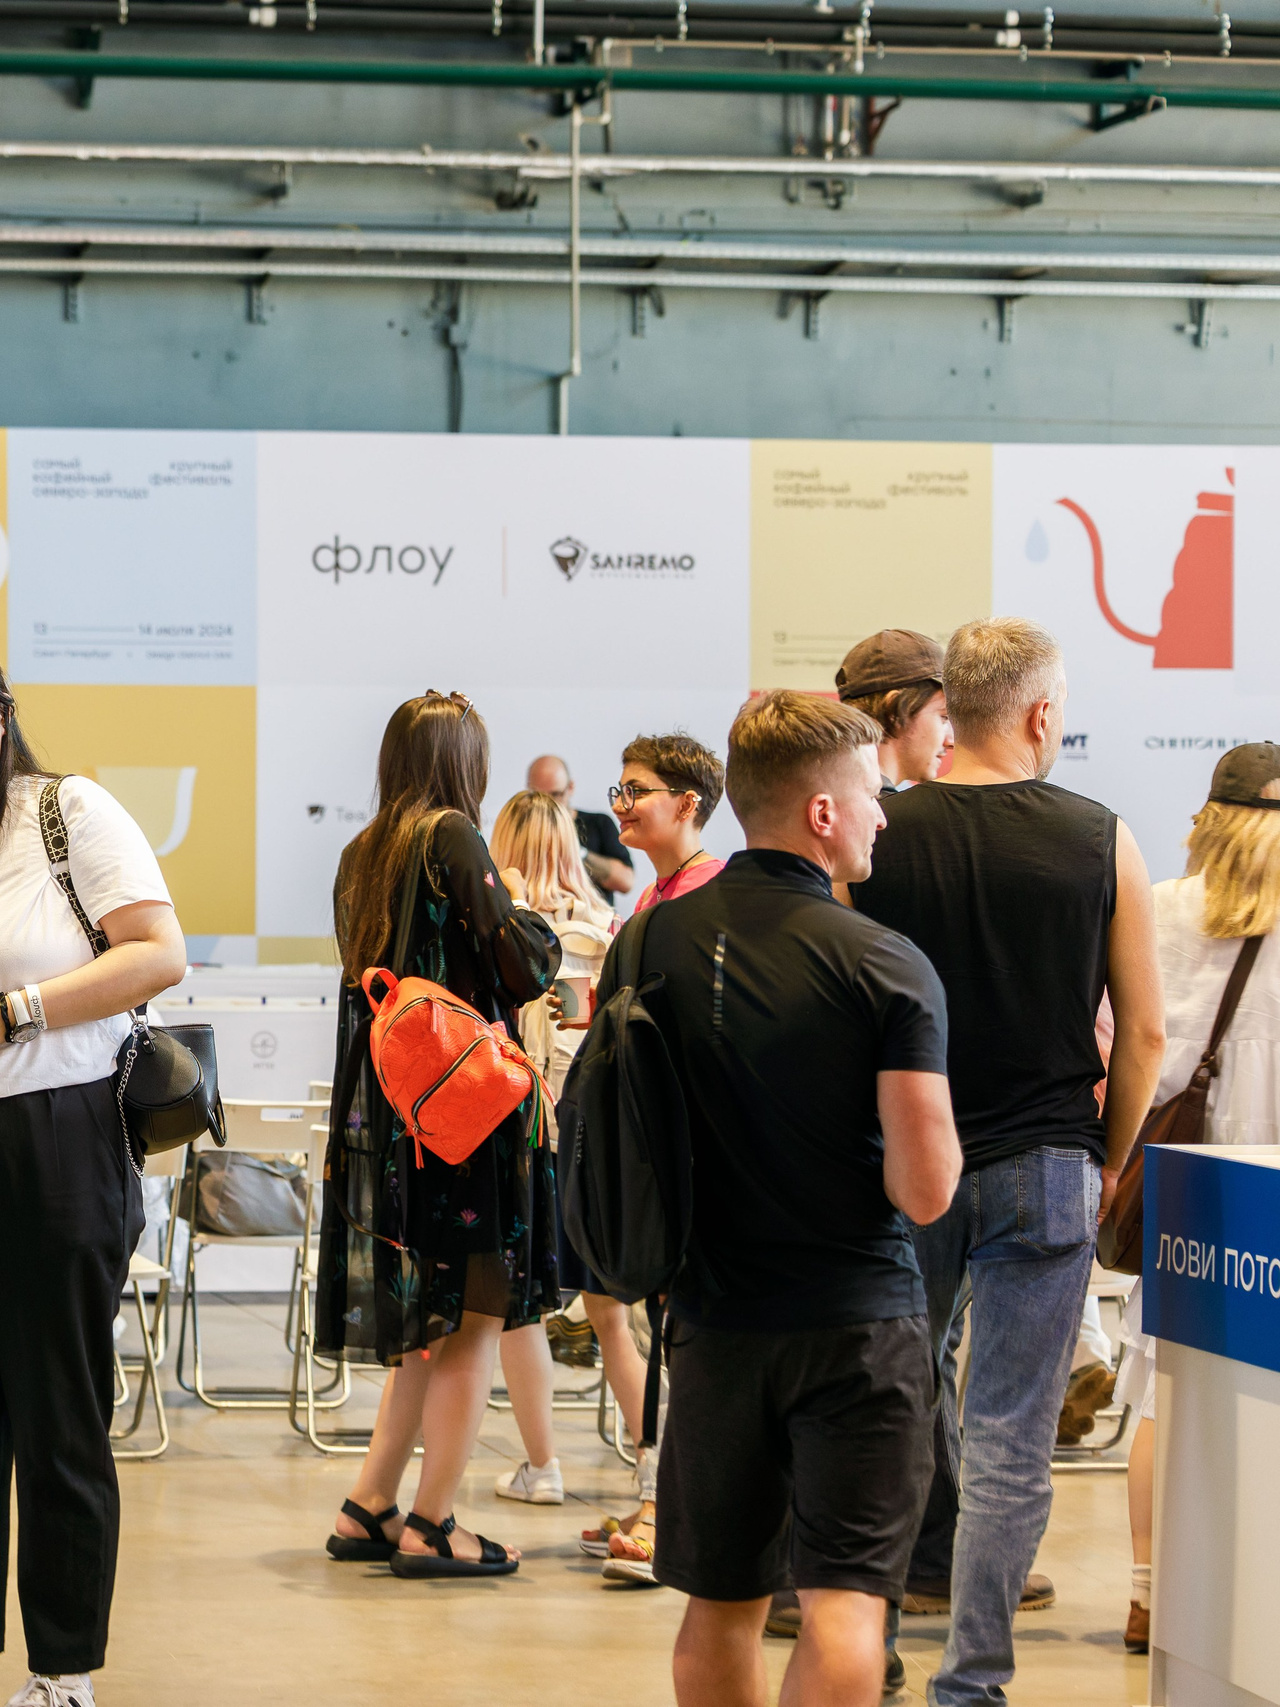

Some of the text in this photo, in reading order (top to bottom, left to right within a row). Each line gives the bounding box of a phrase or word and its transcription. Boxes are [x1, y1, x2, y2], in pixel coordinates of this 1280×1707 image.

[311, 534, 455, 587] флоу
[590, 552, 696, 572] SANREMO
[1062, 734, 1089, 748] WT
[1156, 1233, 1280, 1300] ЛОВИ ПОТО
